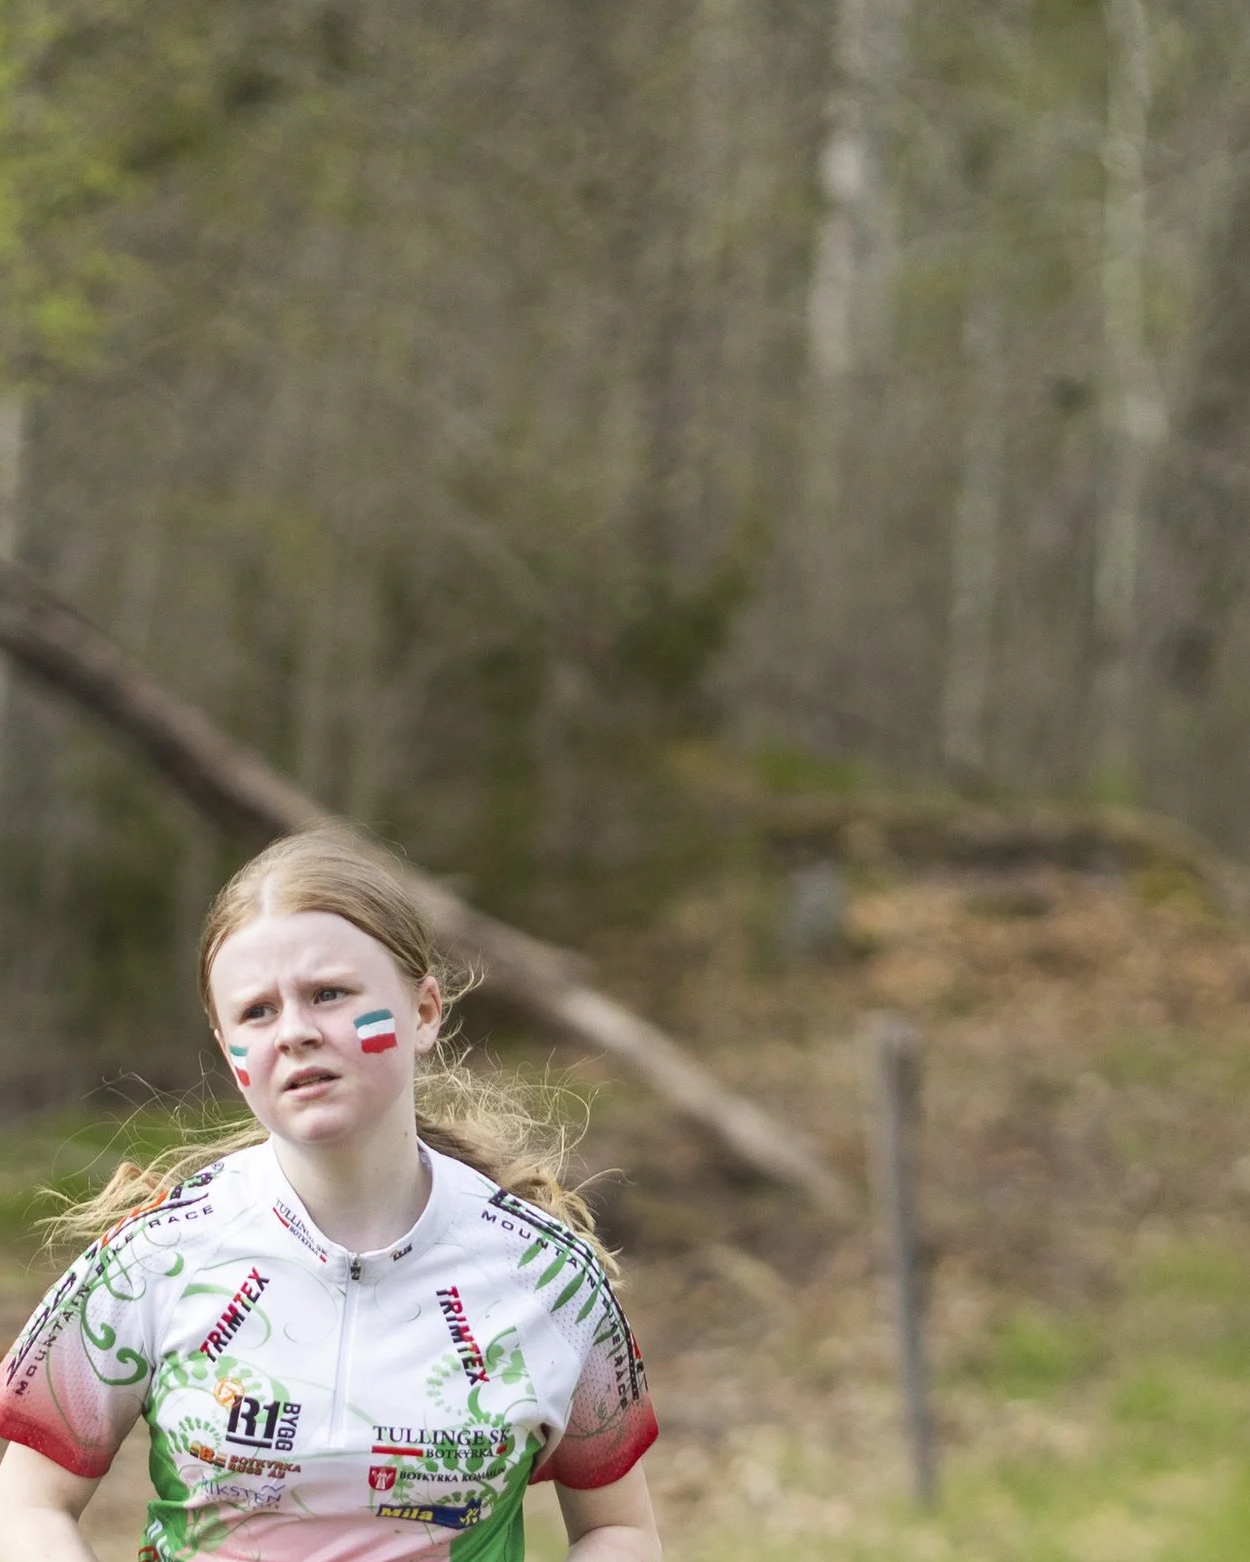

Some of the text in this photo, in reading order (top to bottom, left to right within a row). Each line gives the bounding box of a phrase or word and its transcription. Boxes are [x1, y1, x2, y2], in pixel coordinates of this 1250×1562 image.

[149, 1204, 215, 1229] RACE
[481, 1209, 597, 1290] MOUNTAIN
[199, 1266, 270, 1362] TRIMTEX
[436, 1286, 490, 1386] TRIMTEX
[227, 1395, 281, 1440] R1
[275, 1401, 302, 1452] BYGG
[373, 1425, 485, 1446] TULLINGE
[426, 1447, 494, 1459] BOTKYRKA
[399, 1470, 458, 1483] BOTKYRKA
[381, 1507, 434, 1521] Mila
